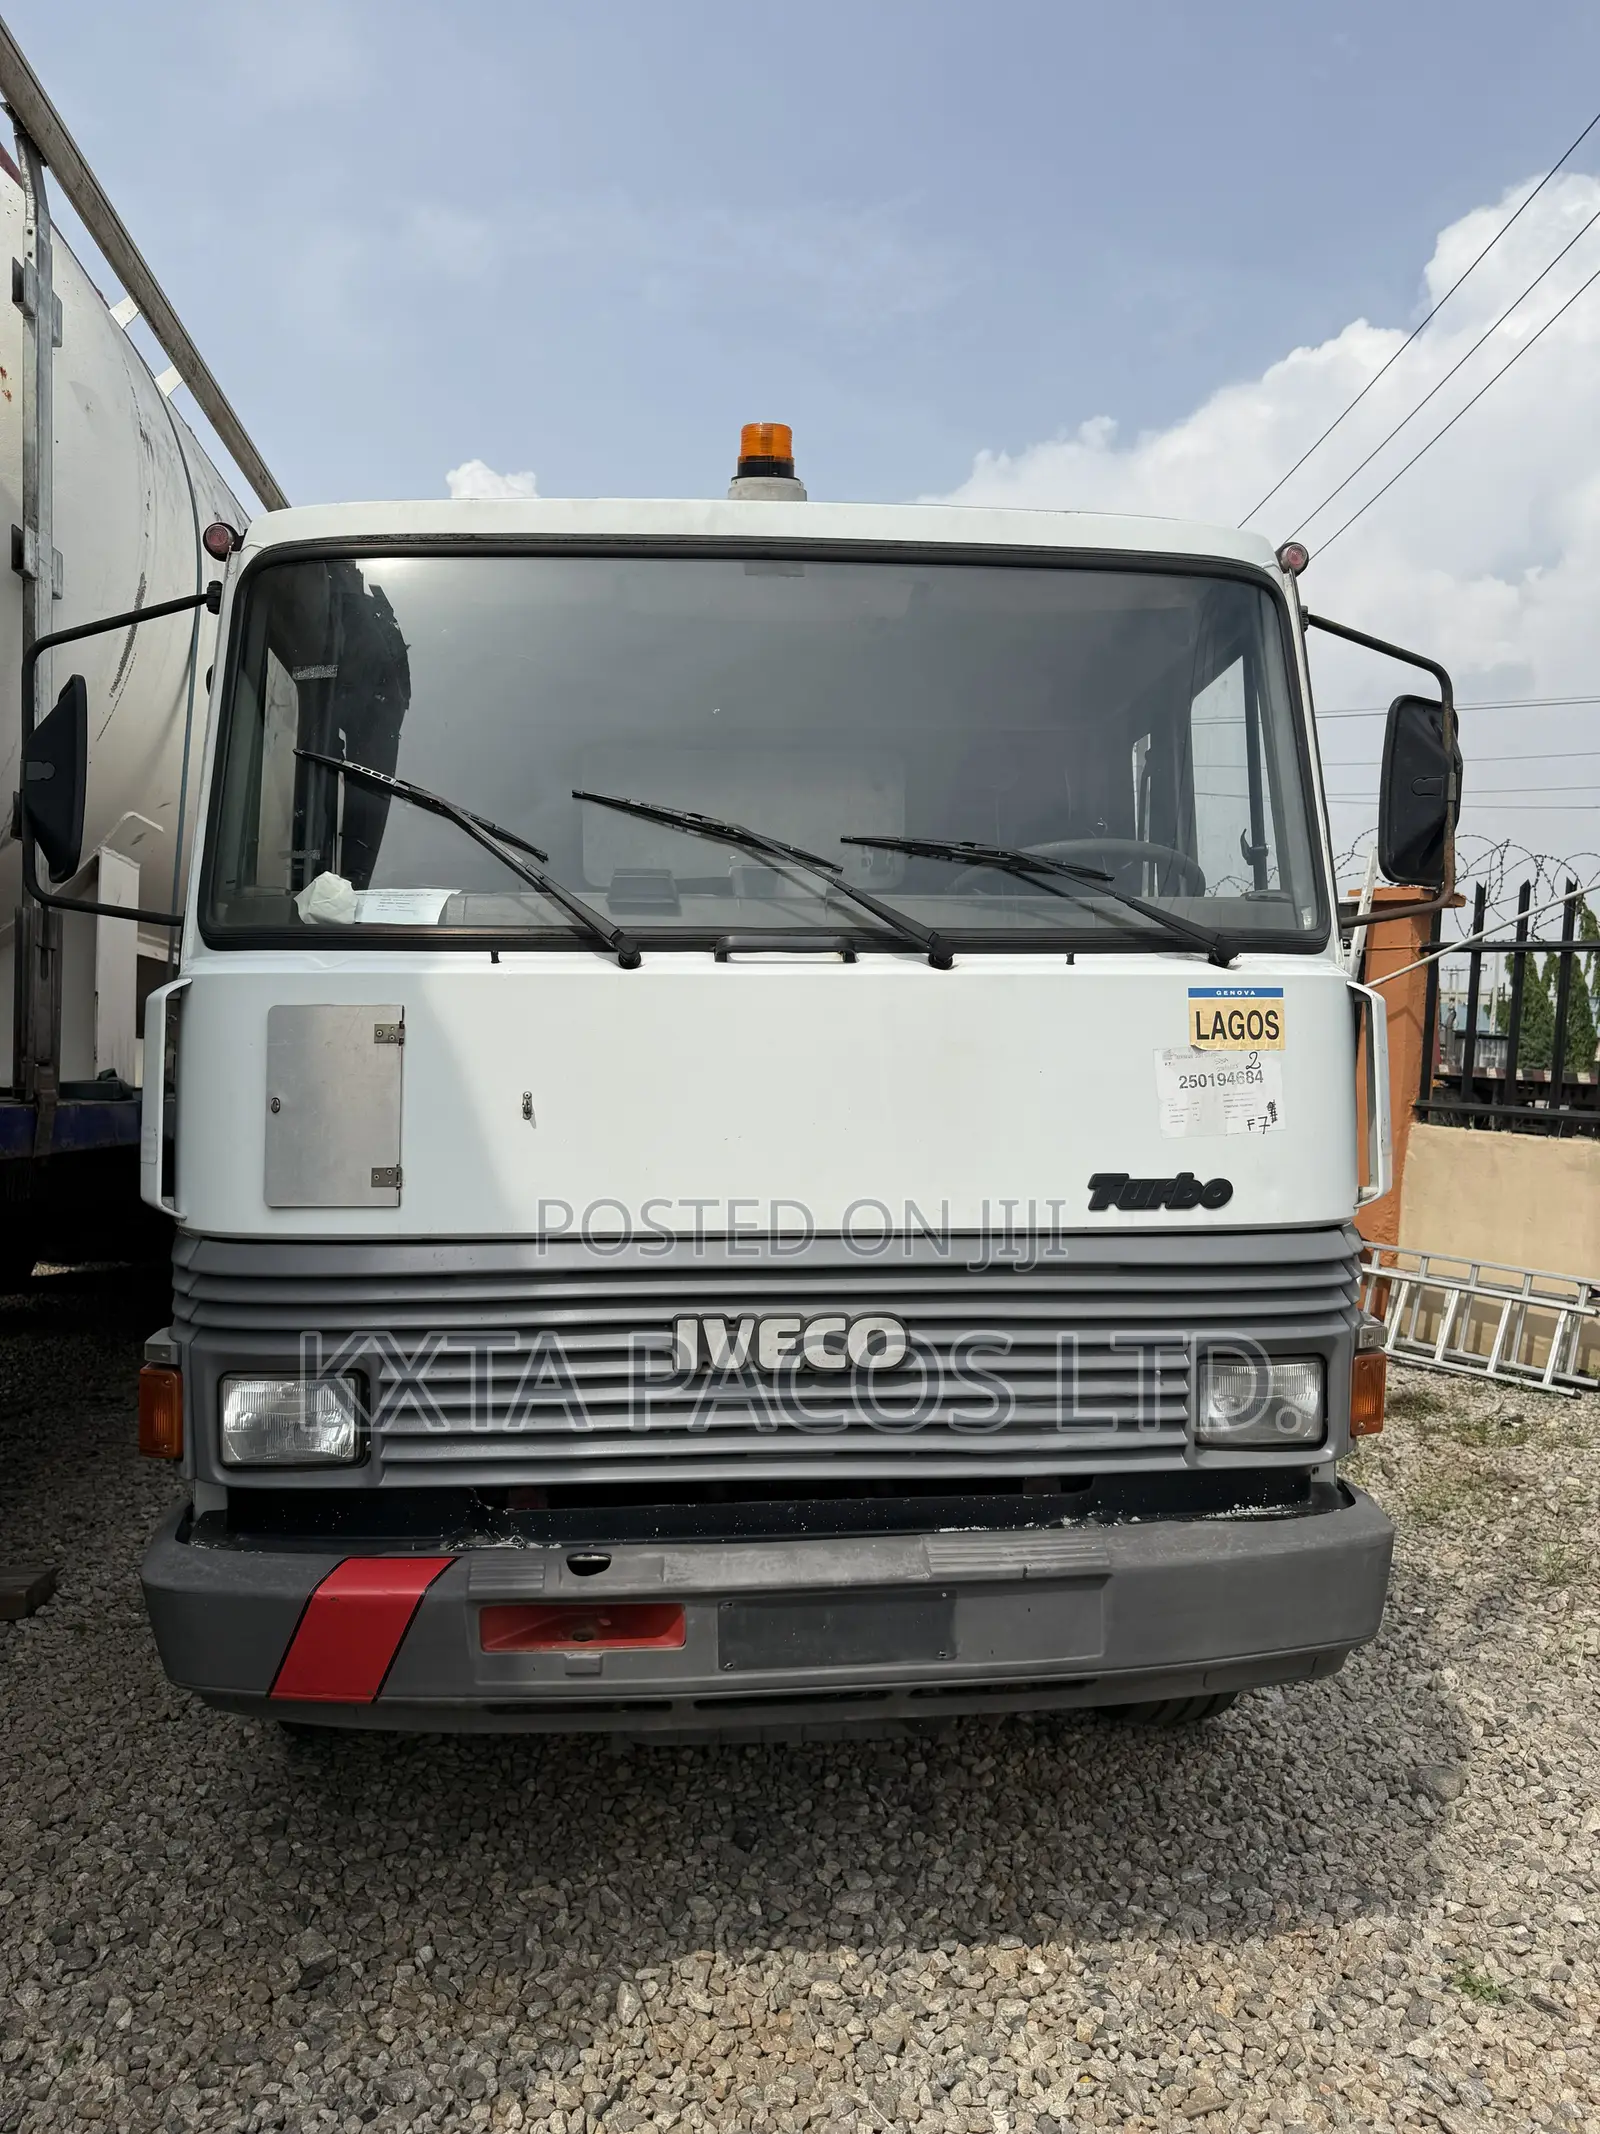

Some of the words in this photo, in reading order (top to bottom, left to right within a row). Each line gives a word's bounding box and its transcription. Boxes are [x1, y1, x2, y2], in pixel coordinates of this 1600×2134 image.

[1195, 1010, 1280, 1040] LAGOS
[1245, 1051, 1262, 1070] 2
[1178, 1069, 1264, 1089] 250194684
[1088, 1172, 1233, 1210] Turbo
[673, 1313, 909, 1371] IVECO
